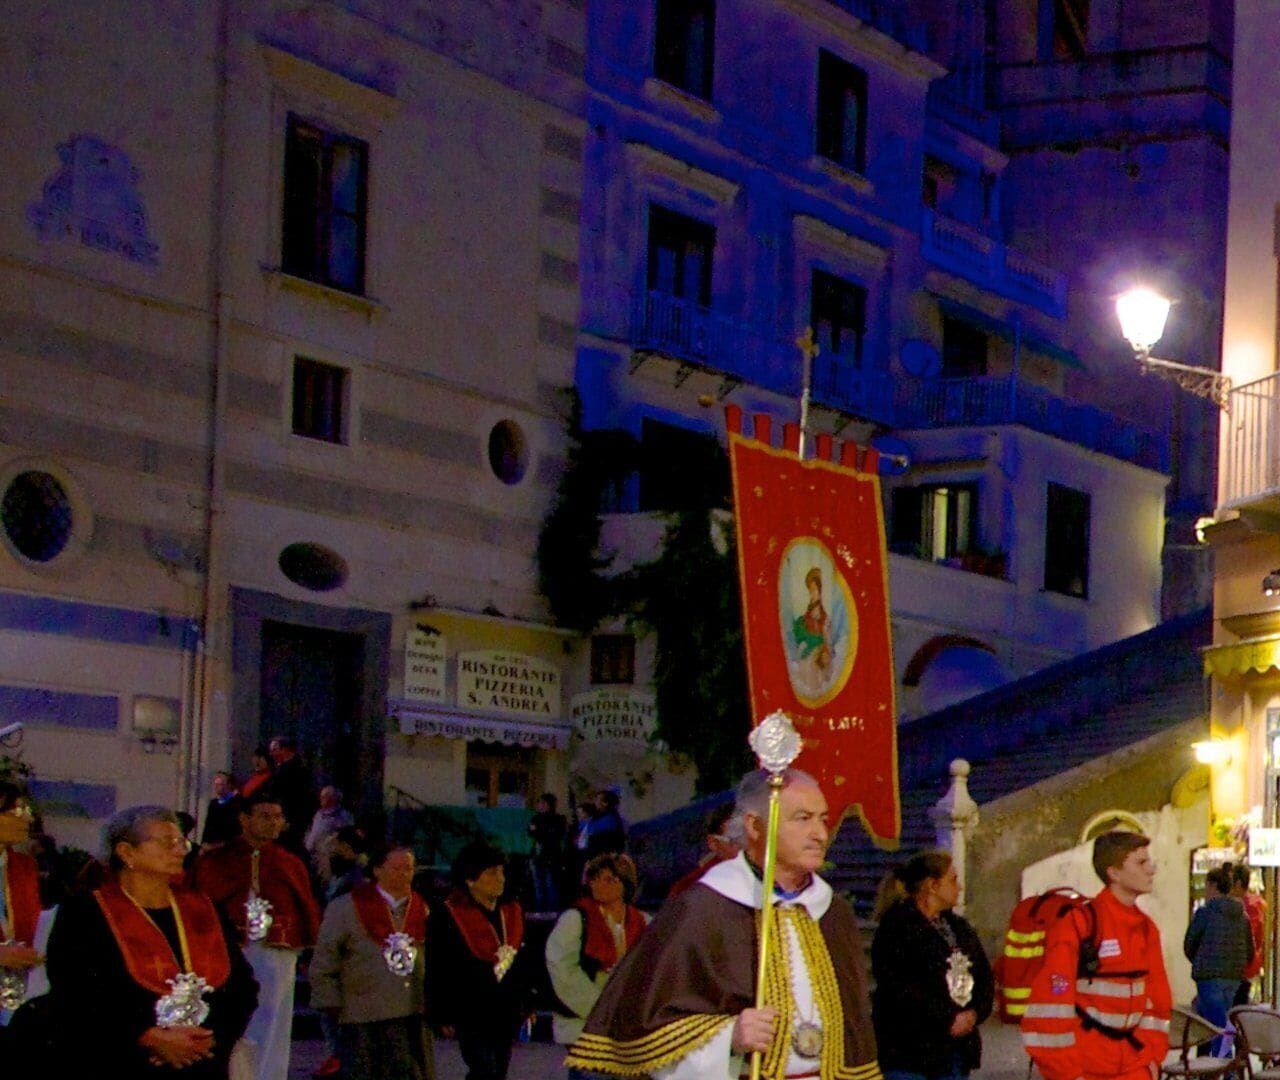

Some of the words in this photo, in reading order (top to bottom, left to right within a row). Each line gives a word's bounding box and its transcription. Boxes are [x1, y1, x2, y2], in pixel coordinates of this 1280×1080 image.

[462, 659, 555, 682] RISTORANTE
[475, 677, 544, 698] PIZZERIA
[489, 694, 551, 713] ANDREA
